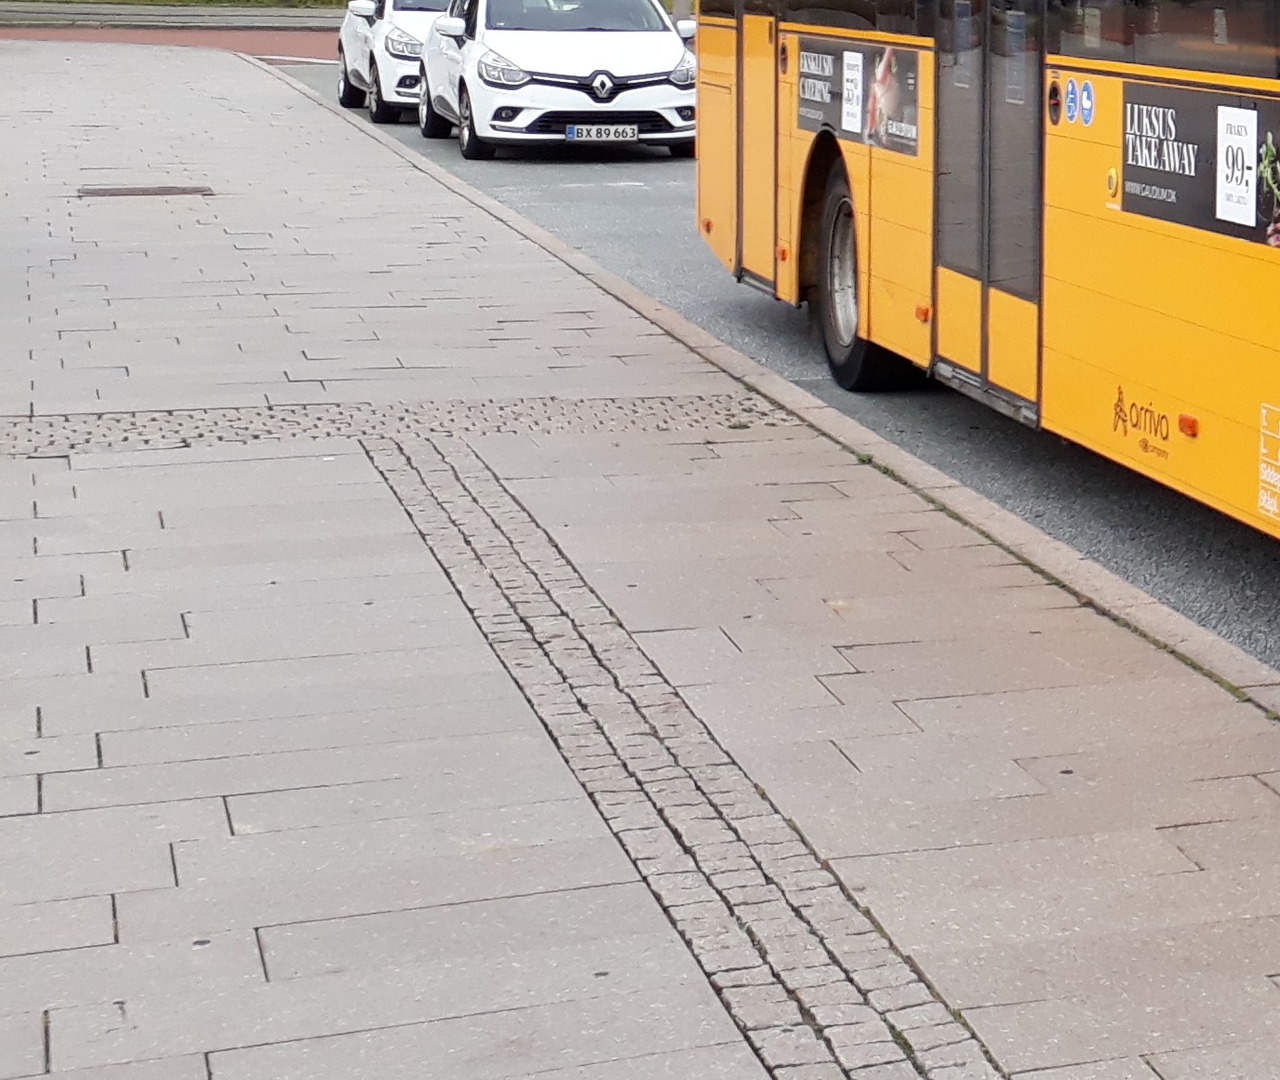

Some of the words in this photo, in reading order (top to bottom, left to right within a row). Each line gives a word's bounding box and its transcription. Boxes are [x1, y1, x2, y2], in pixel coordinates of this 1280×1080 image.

[576, 128, 592, 138] BX
[596, 128, 610, 138] 89
[613, 128, 636, 138] 663
[1126, 103, 1176, 140] LUKSUS
[1126, 134, 1159, 169] TAKE
[1160, 141, 1198, 176] AWAY
